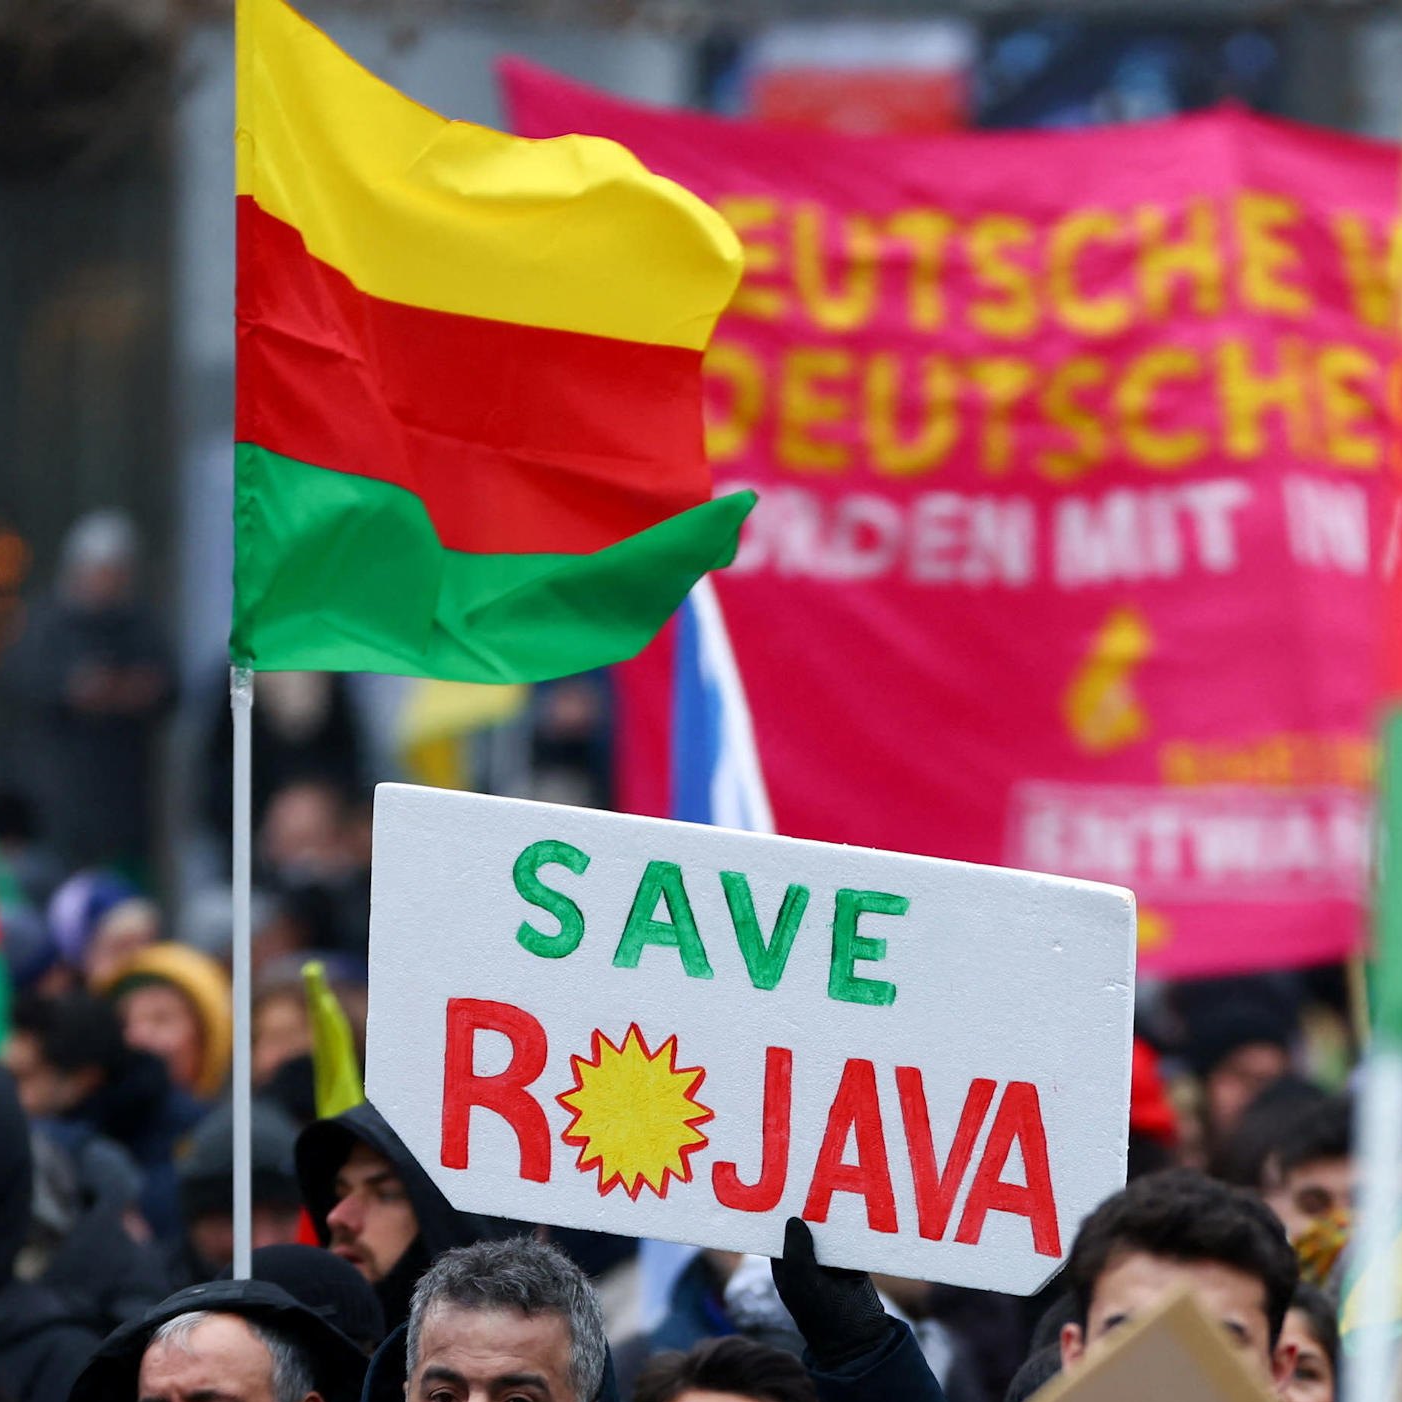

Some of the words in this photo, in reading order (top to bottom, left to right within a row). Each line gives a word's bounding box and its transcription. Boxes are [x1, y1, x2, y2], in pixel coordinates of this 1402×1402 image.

[710, 187, 1316, 342] EUTSCHE
[710, 481, 1036, 591] ORDEN
[1052, 474, 1254, 592] MIT
[1282, 474, 1370, 580] IN
[511, 838, 910, 1007] SAVE
